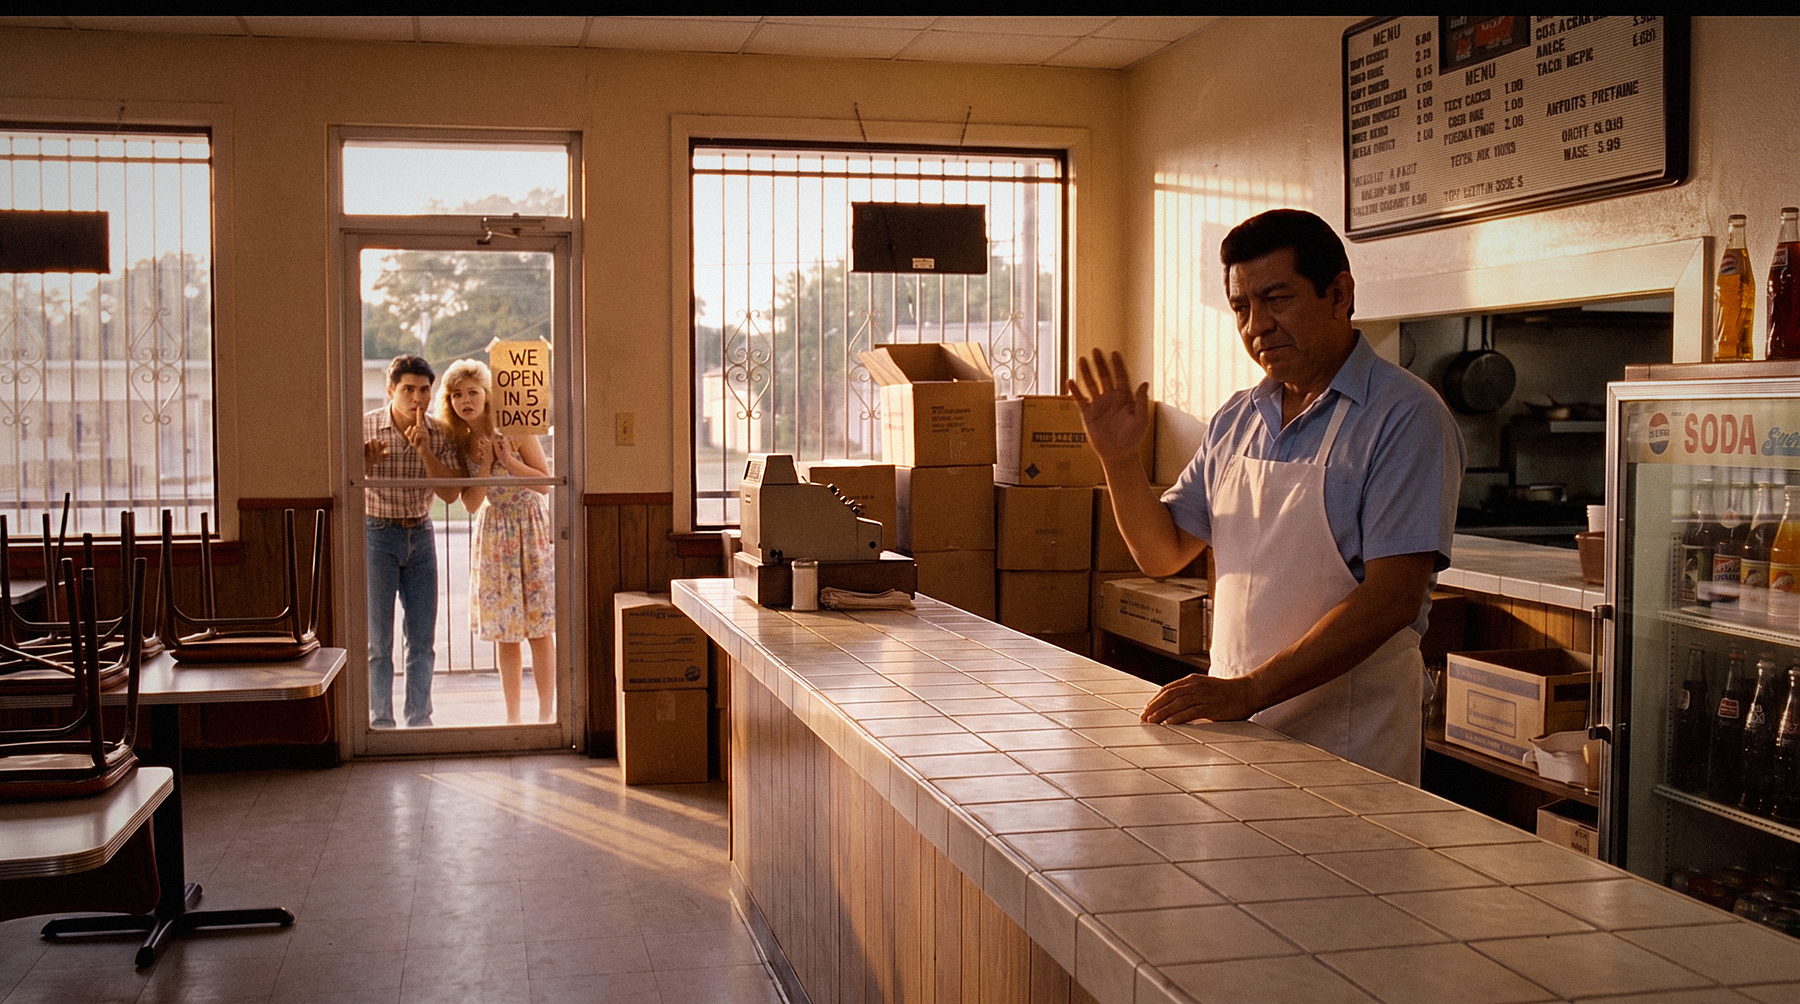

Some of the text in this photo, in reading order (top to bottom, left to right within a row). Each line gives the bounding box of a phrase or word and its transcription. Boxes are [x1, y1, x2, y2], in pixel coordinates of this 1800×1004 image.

[1373, 24, 1401, 47] MENU
[1466, 62, 1496, 86] MENU
[509, 349, 538, 366] WE
[497, 370, 544, 388] OPEN
[504, 389, 538, 406] IN 5
[1684, 413, 1756, 455] SODA
